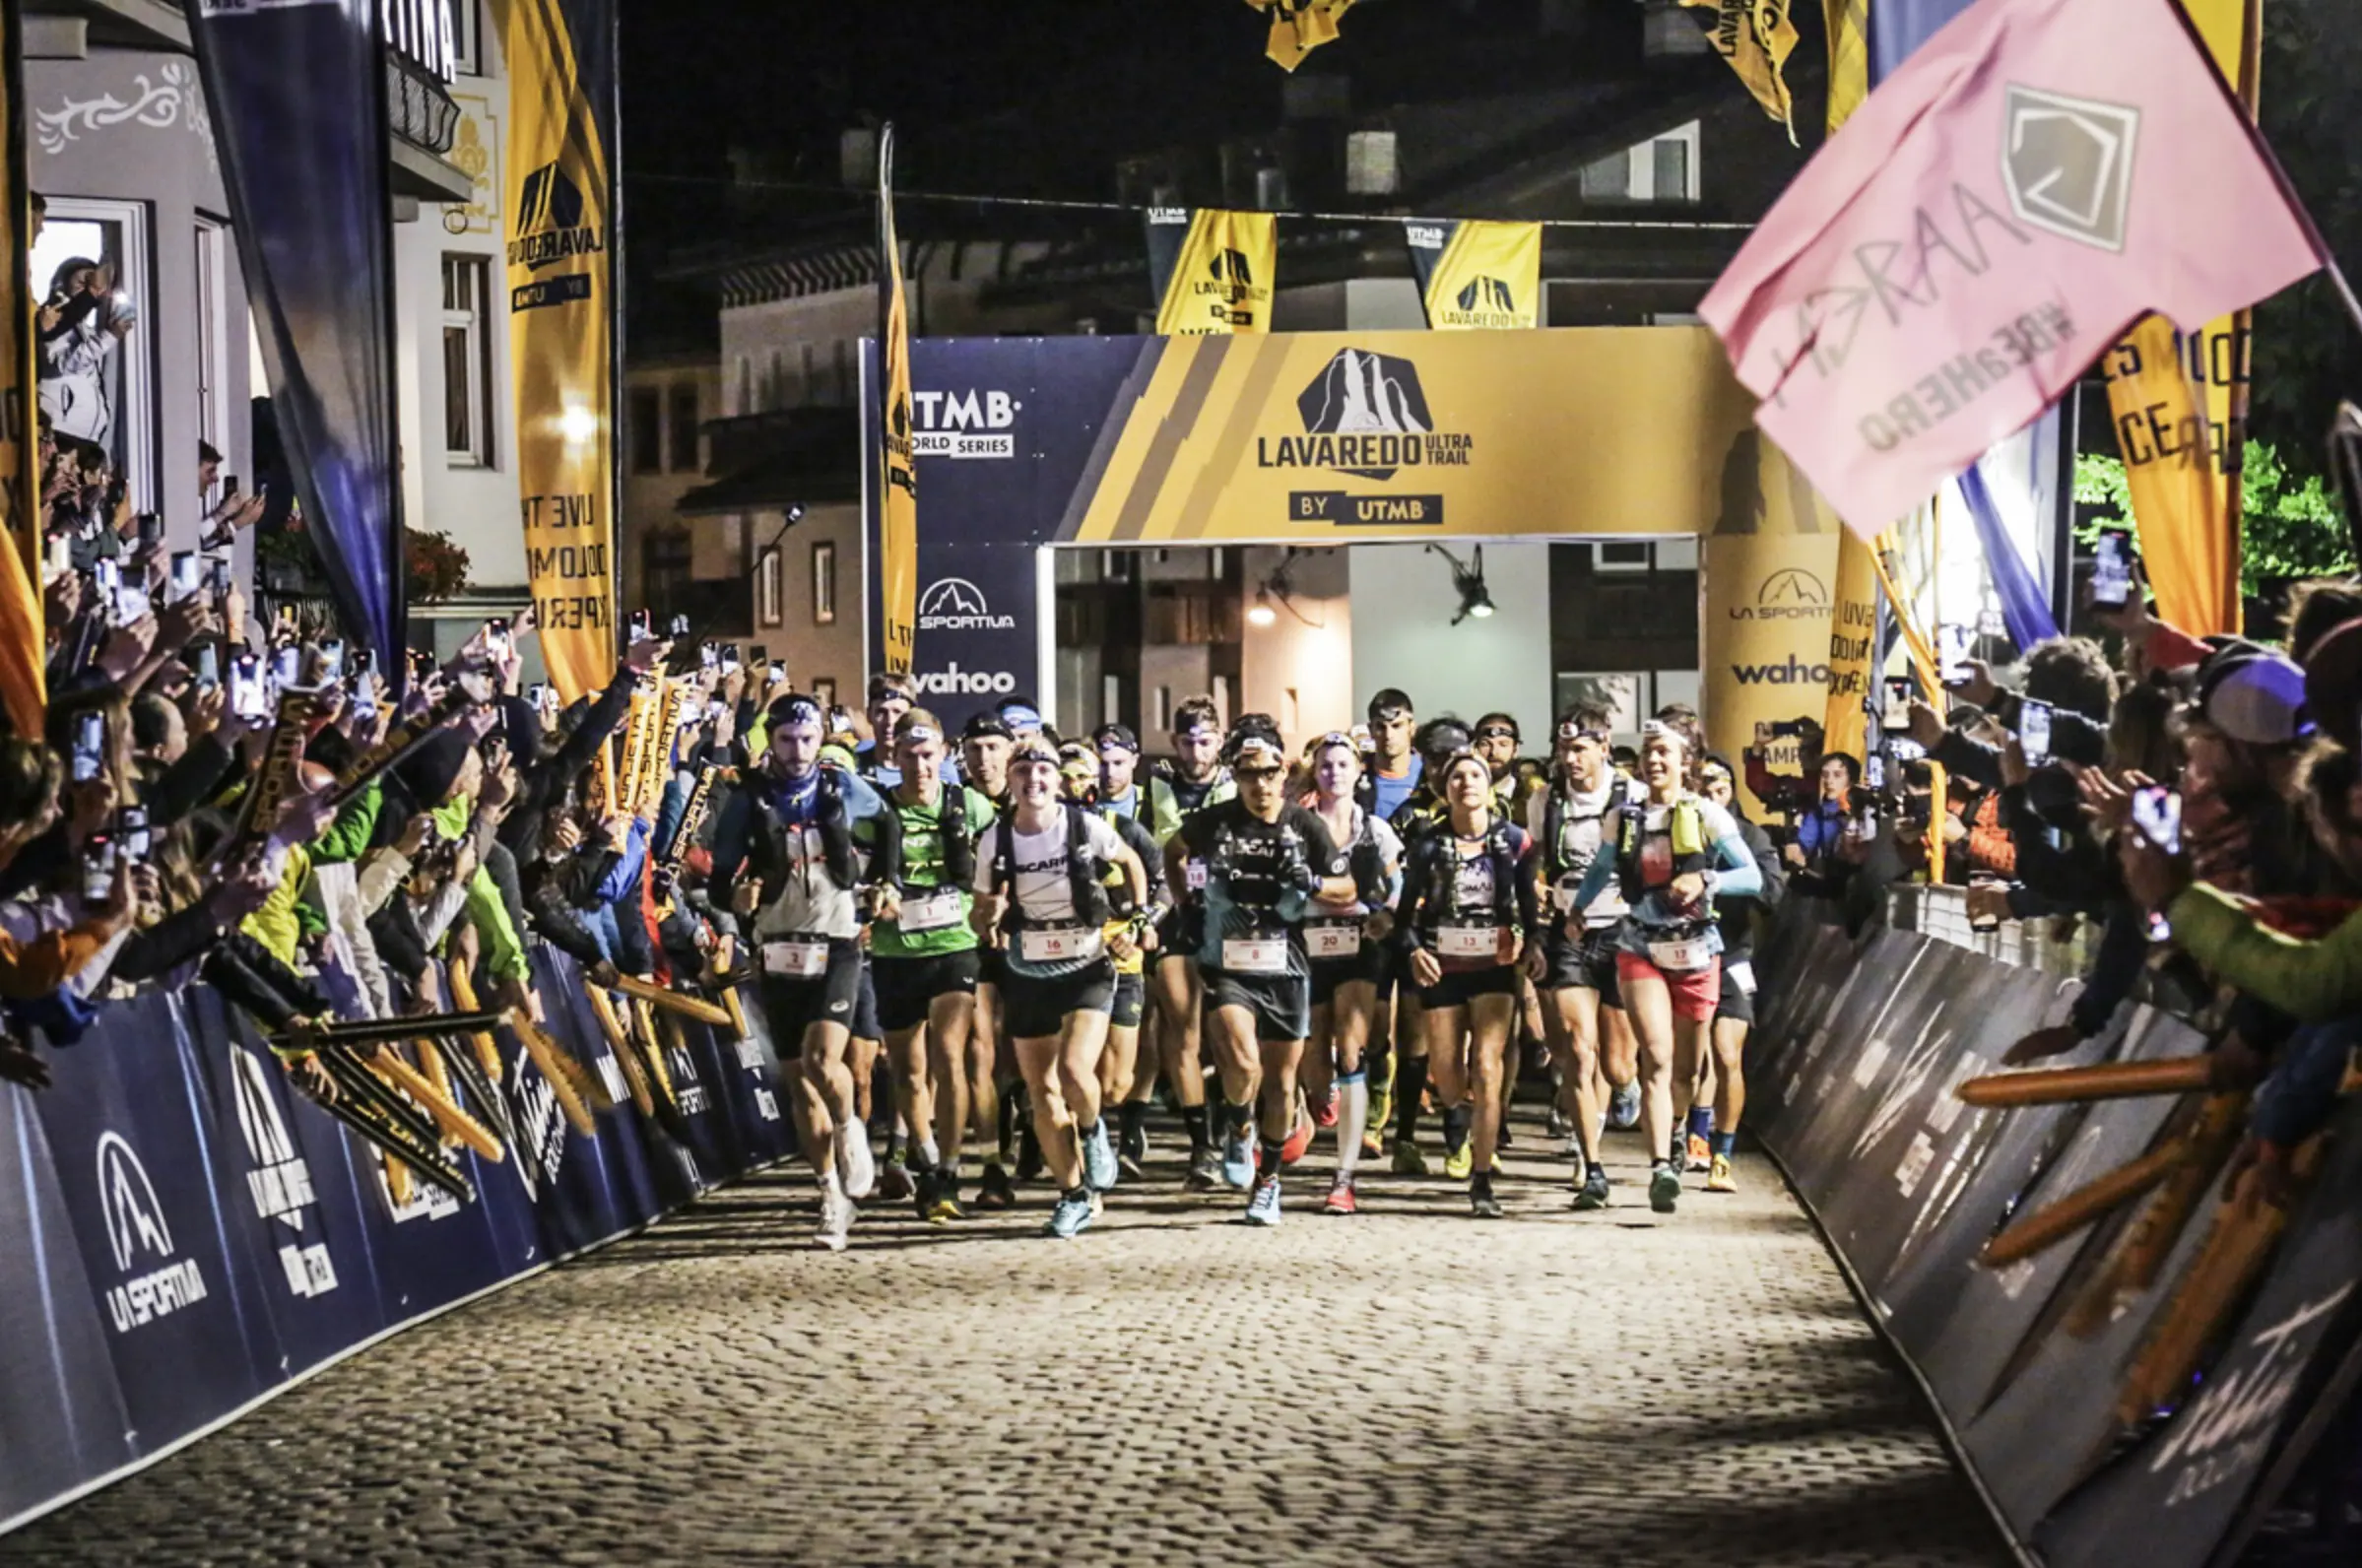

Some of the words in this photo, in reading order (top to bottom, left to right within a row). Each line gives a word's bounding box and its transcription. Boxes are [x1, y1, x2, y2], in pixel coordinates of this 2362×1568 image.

[912, 436, 951, 450] ORLD
[957, 438, 1009, 454] SERIES
[1258, 433, 1421, 469] LAVAREDO
[1425, 433, 1474, 450] ULTRA
[1425, 450, 1470, 466] TRAIL
[1300, 496, 1329, 516] BY
[1356, 499, 1424, 521] UTMB
[919, 615, 1016, 629] SPORTIVA
[1730, 607, 1754, 621] LA
[672, 765, 718, 860] SPORTIVA
[127, 1257, 208, 1326] SPORTIVA
